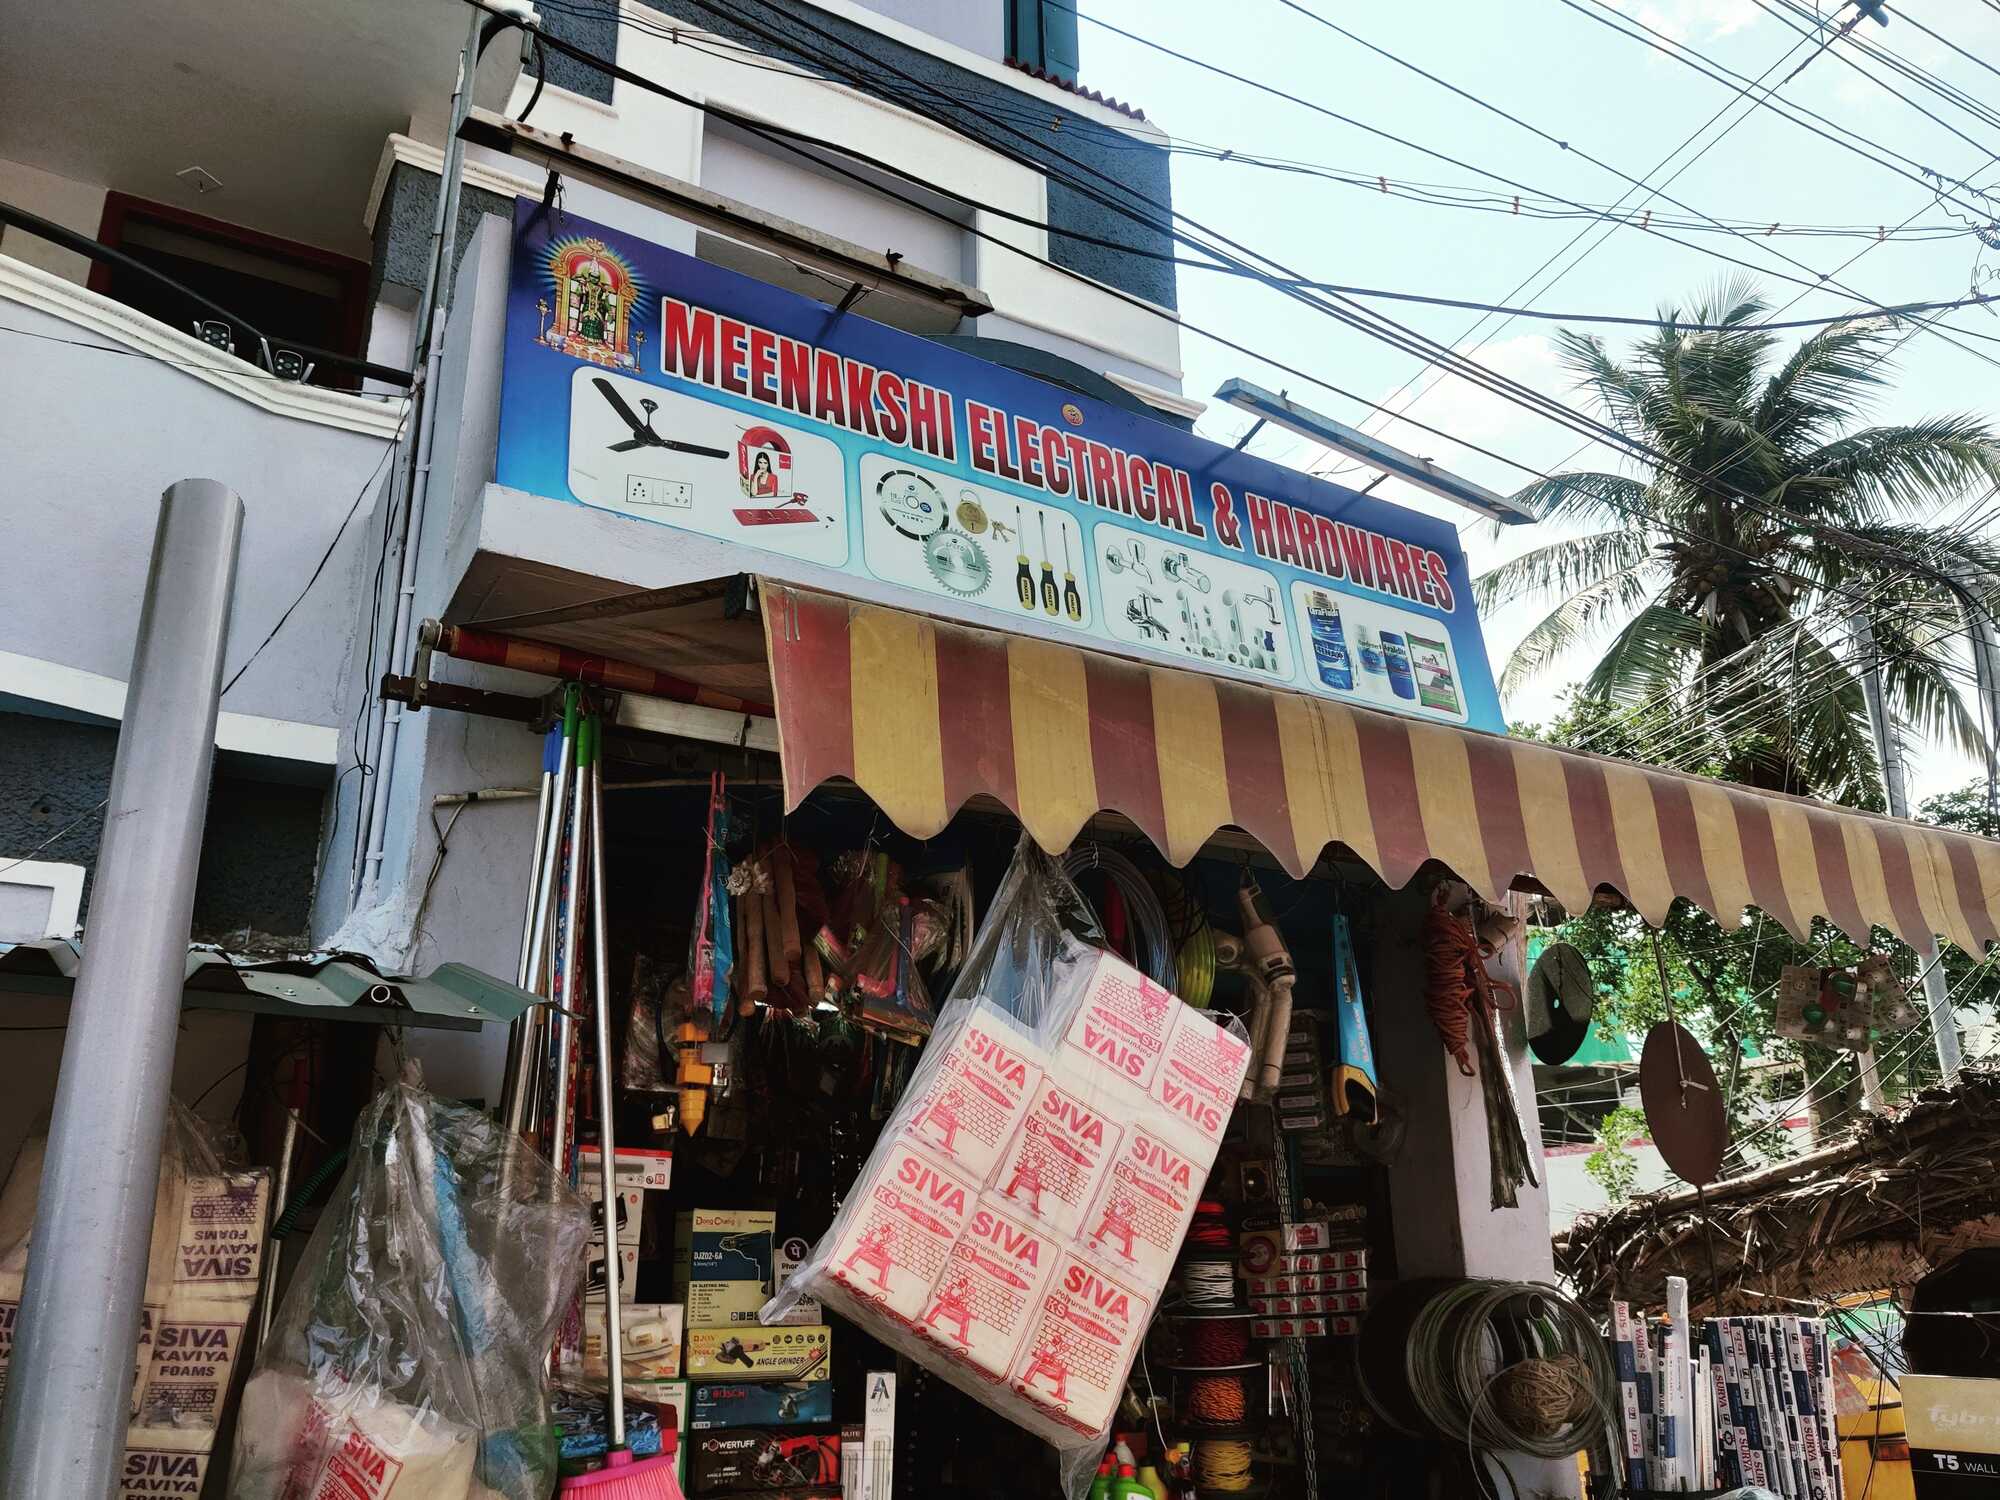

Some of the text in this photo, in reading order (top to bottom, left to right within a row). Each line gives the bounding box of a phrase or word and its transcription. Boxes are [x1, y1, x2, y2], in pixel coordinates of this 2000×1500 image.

[660, 296, 1456, 613] MEENAKSHI ELECTRICAL & HARDWARES
[964, 1029, 1026, 1090] SIVA
[1084, 1023, 1145, 1077] SIVA
[1042, 1090, 1103, 1147] SIVA
[1162, 1079, 1222, 1132] SIVA
[1024, 1115, 1048, 1137] KS
[1114, 1162, 1136, 1183] KS
[1132, 1136, 1191, 1190] SIVA
[873, 1185, 901, 1209] KS
[898, 1157, 965, 1216] SIVA
[194, 1229, 248, 1240] FOAMS
[972, 1211, 1039, 1267] SIVA
[181, 1243, 258, 1256] KAVIYA
[951, 1241, 977, 1262] KS
[183, 1257, 252, 1277] SIVA
[1043, 1295, 1069, 1319] KS
[1064, 1265, 1129, 1324] SIVA
[158, 1327, 229, 1348] SIVA
[1633, 1328, 1646, 1359] SURYA
[152, 1350, 229, 1362] KAVIYA
[756, 1358, 777, 1366] ANGLE
[159, 1365, 216, 1377] FOAMS
[1715, 1374, 1728, 1408] SURYA
[1738, 1437, 1751, 1472] SURYA
[1803, 1426, 1816, 1462] SURYA
[125, 1454, 199, 1478] SIVA
[344, 1432, 386, 1485] SIVA
[1933, 1454, 2000, 1475] T5 WALL
[120, 1478, 198, 1493] KAVIYA
[1753, 1460, 1766, 1488] SURY
